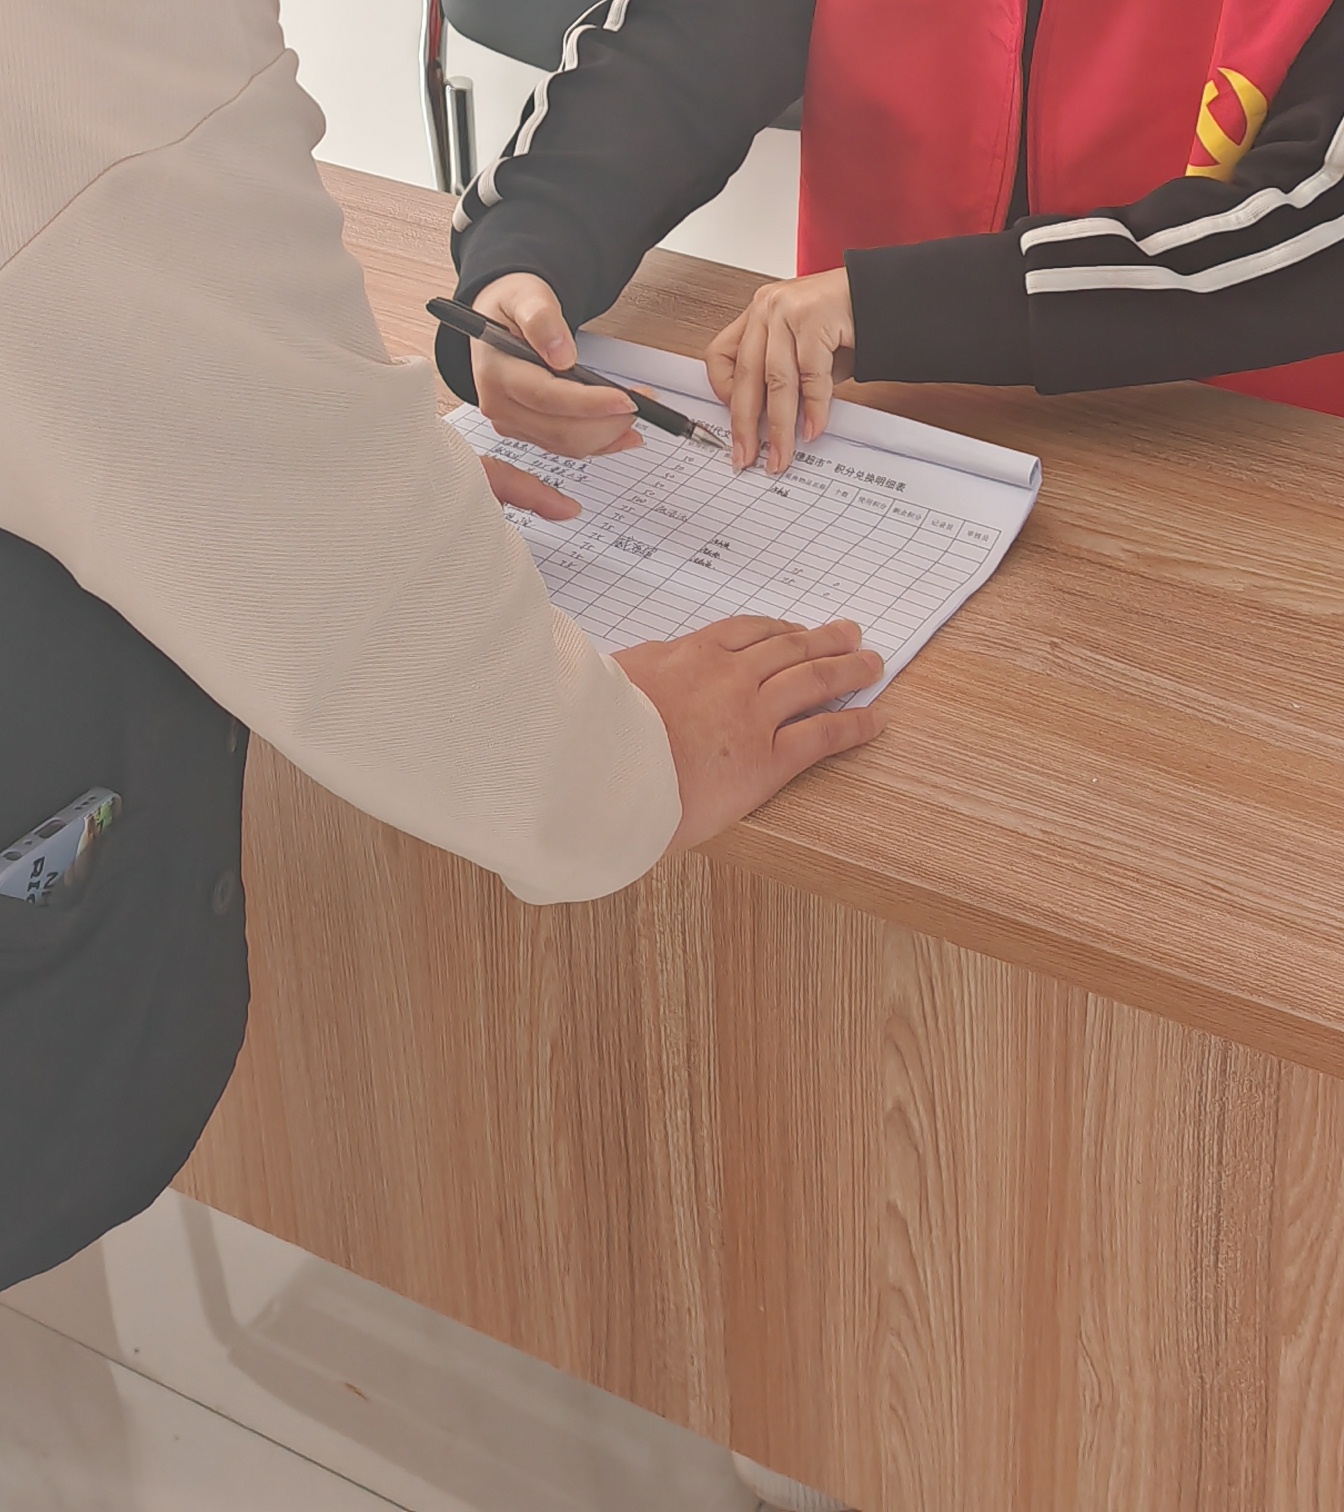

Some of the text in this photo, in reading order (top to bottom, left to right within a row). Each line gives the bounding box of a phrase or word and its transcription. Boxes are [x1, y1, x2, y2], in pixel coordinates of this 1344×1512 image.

[834, 464, 907, 493] 积分兑换明细表
